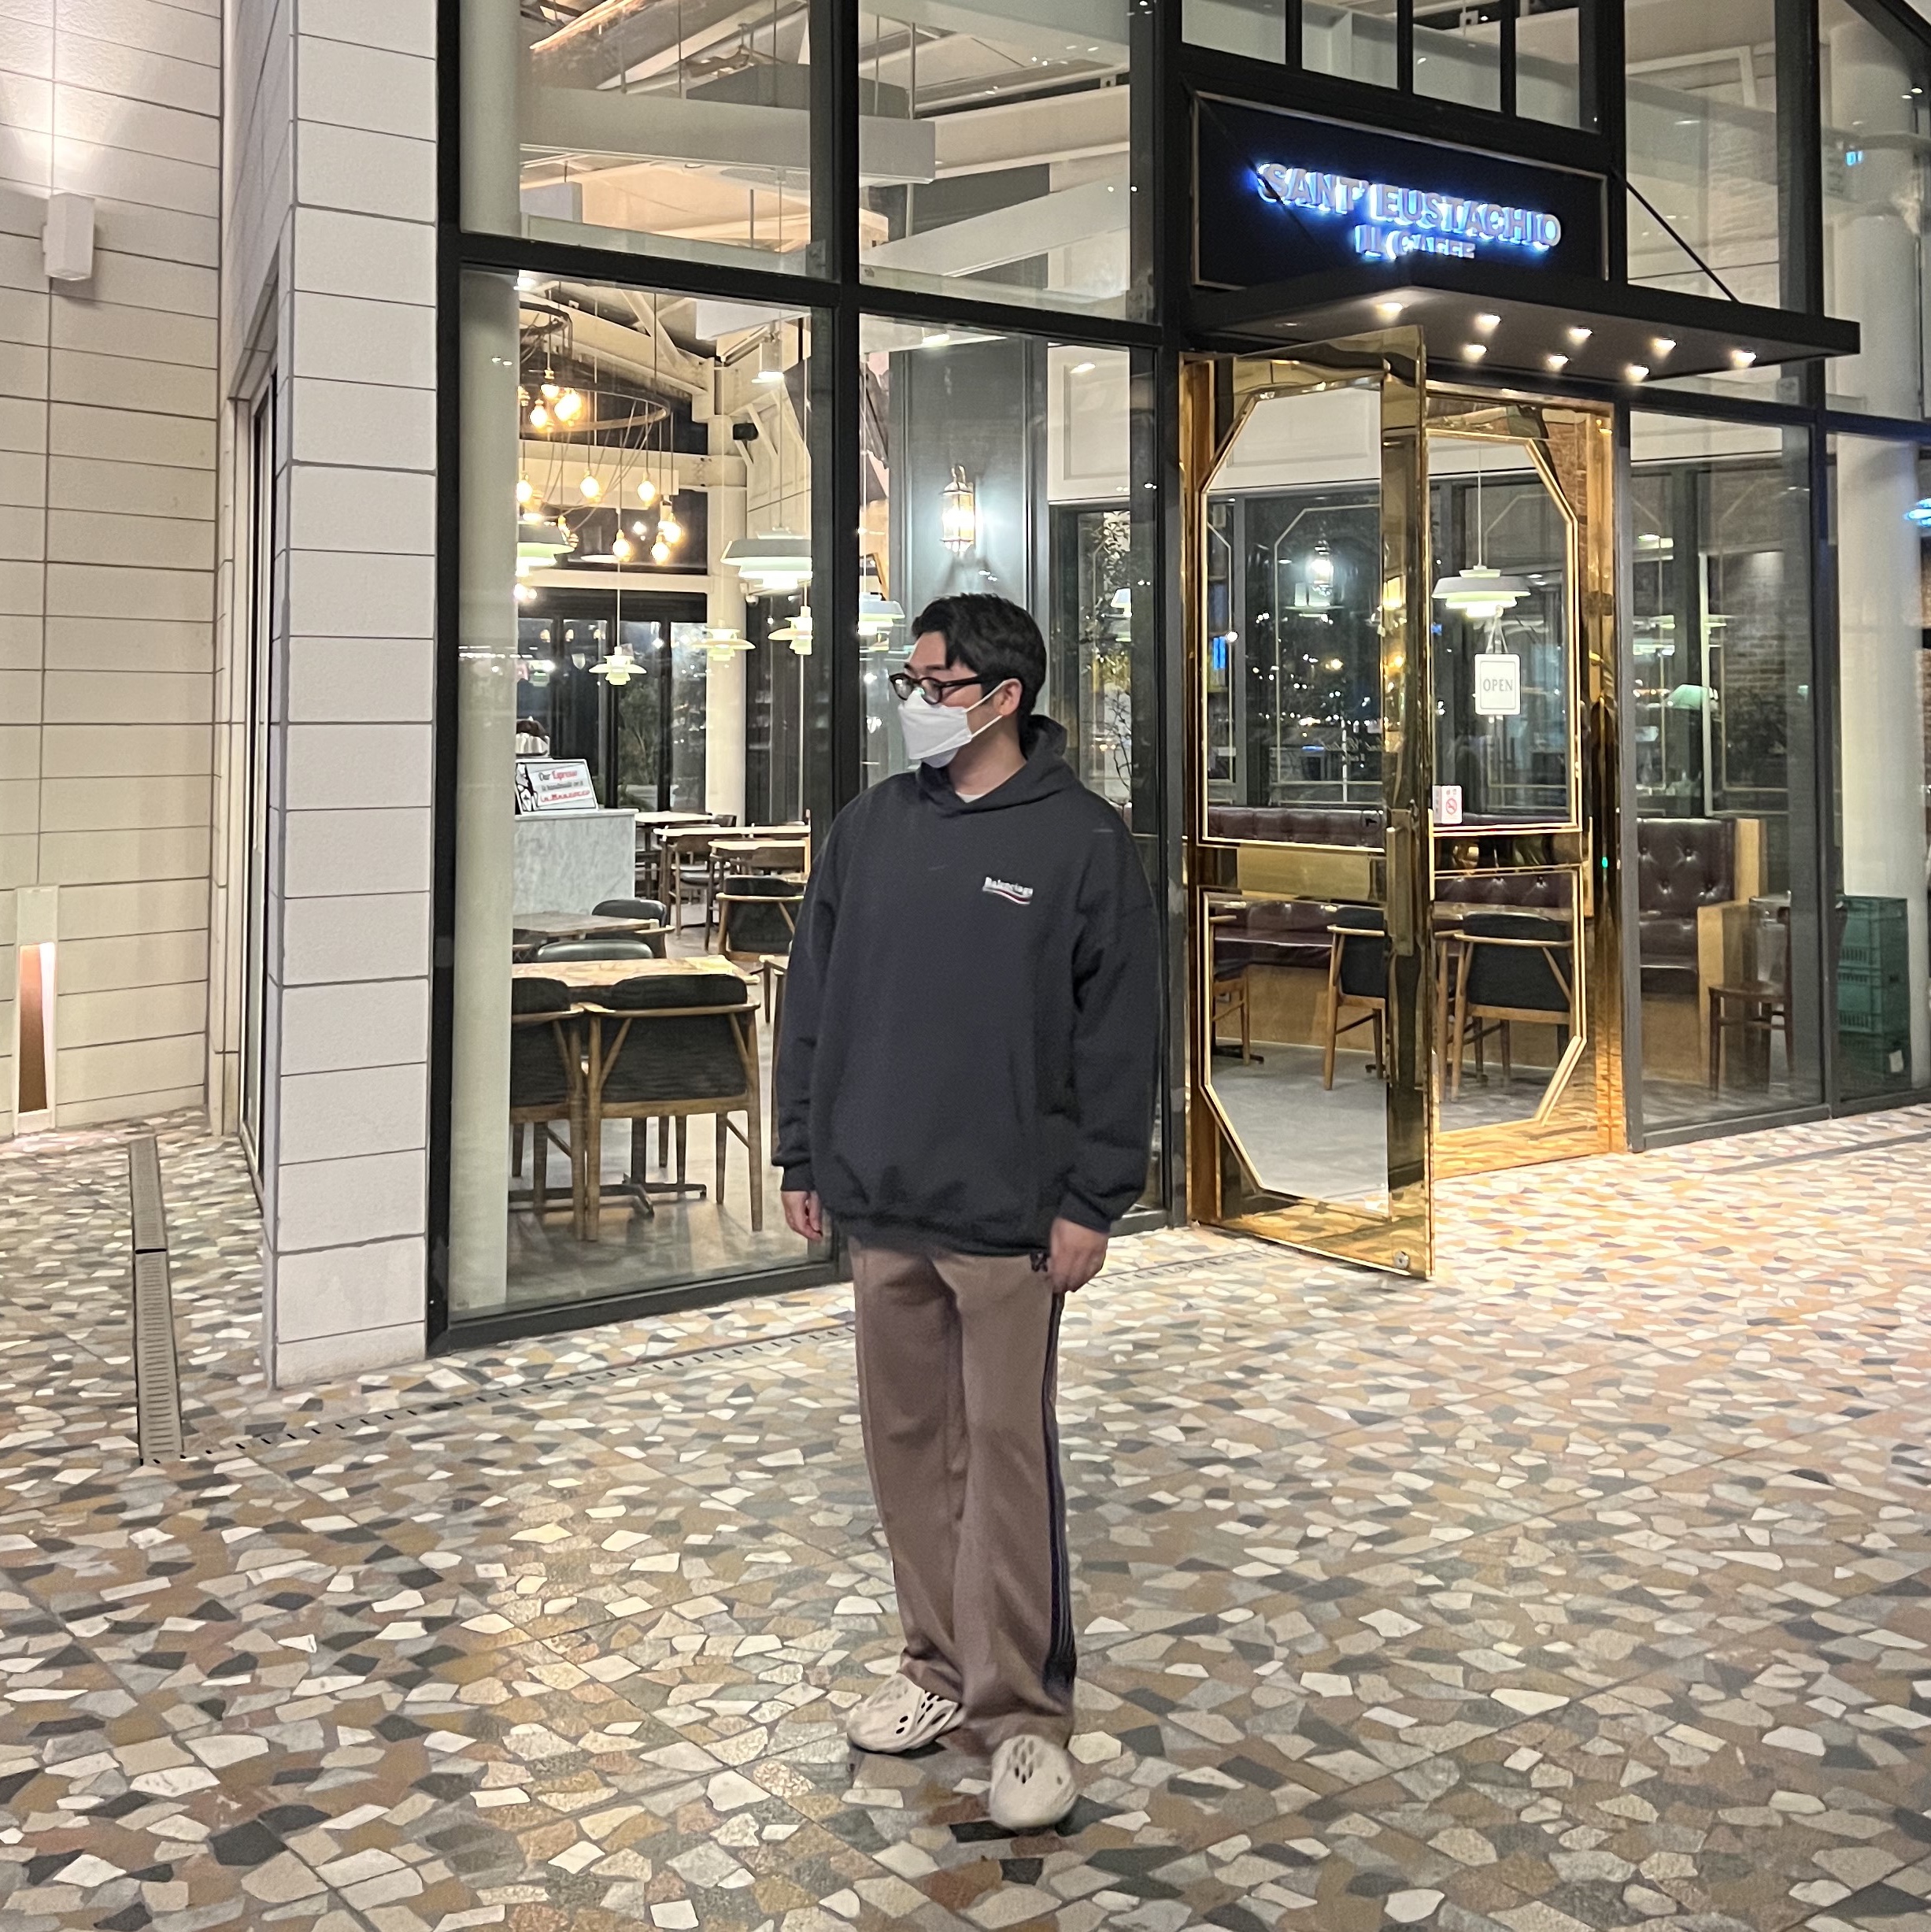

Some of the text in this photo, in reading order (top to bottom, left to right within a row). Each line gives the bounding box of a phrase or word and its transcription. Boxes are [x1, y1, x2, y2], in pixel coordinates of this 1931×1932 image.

[1373, 183, 1562, 249] EUSTACHIO
[1355, 224, 1382, 257] IL
[1482, 678, 1513, 692] OPEN
